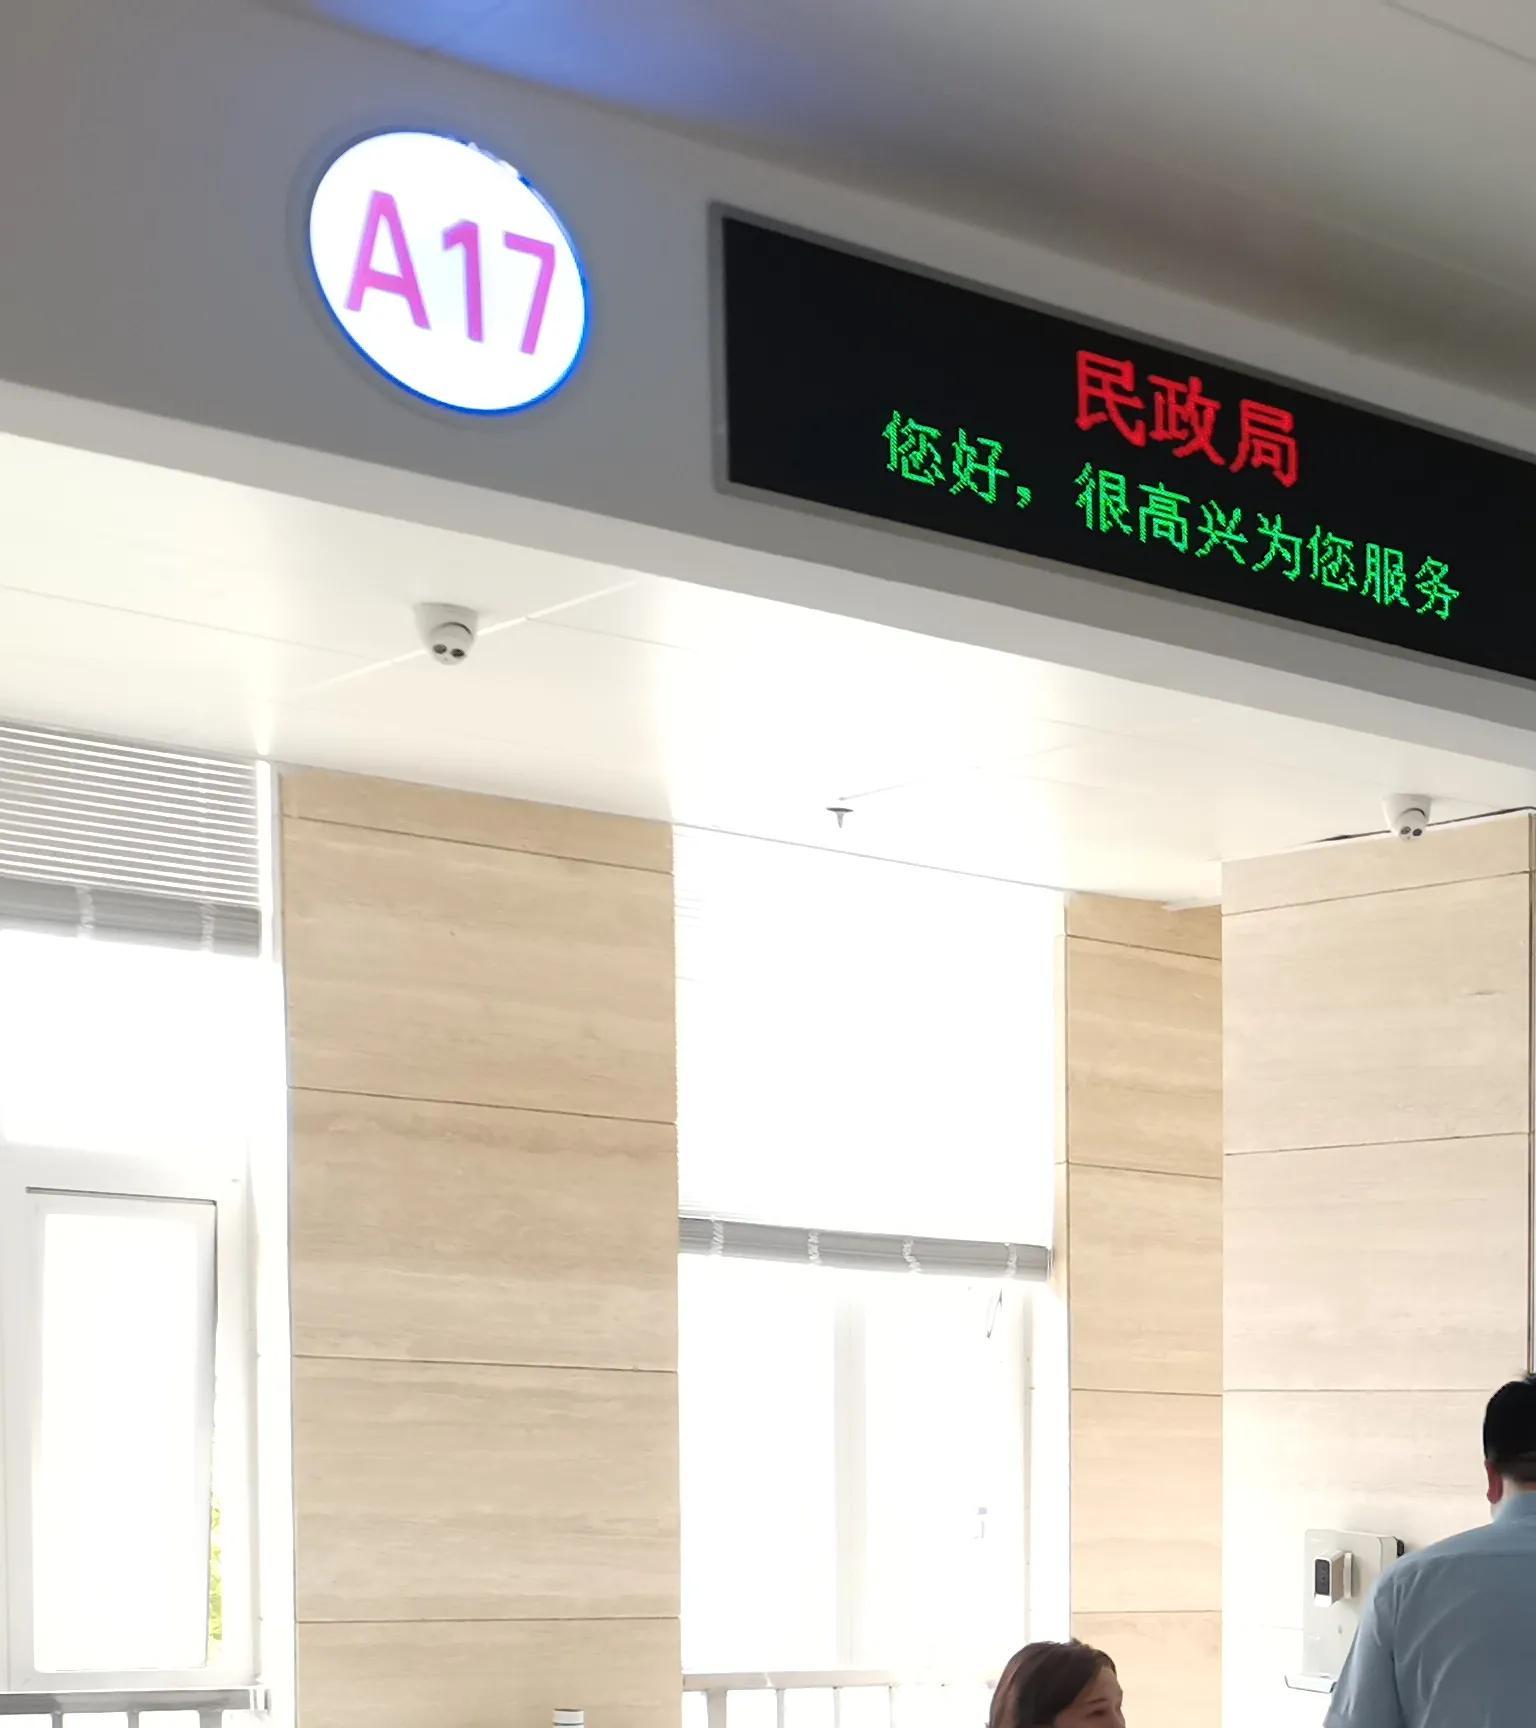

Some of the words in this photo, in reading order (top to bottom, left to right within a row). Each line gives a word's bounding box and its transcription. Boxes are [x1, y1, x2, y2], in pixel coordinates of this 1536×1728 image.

[346, 190, 557, 357] A17
[1076, 350, 1299, 488] 民政局
[882, 411, 1460, 622] 您好，很高兴为您服务
